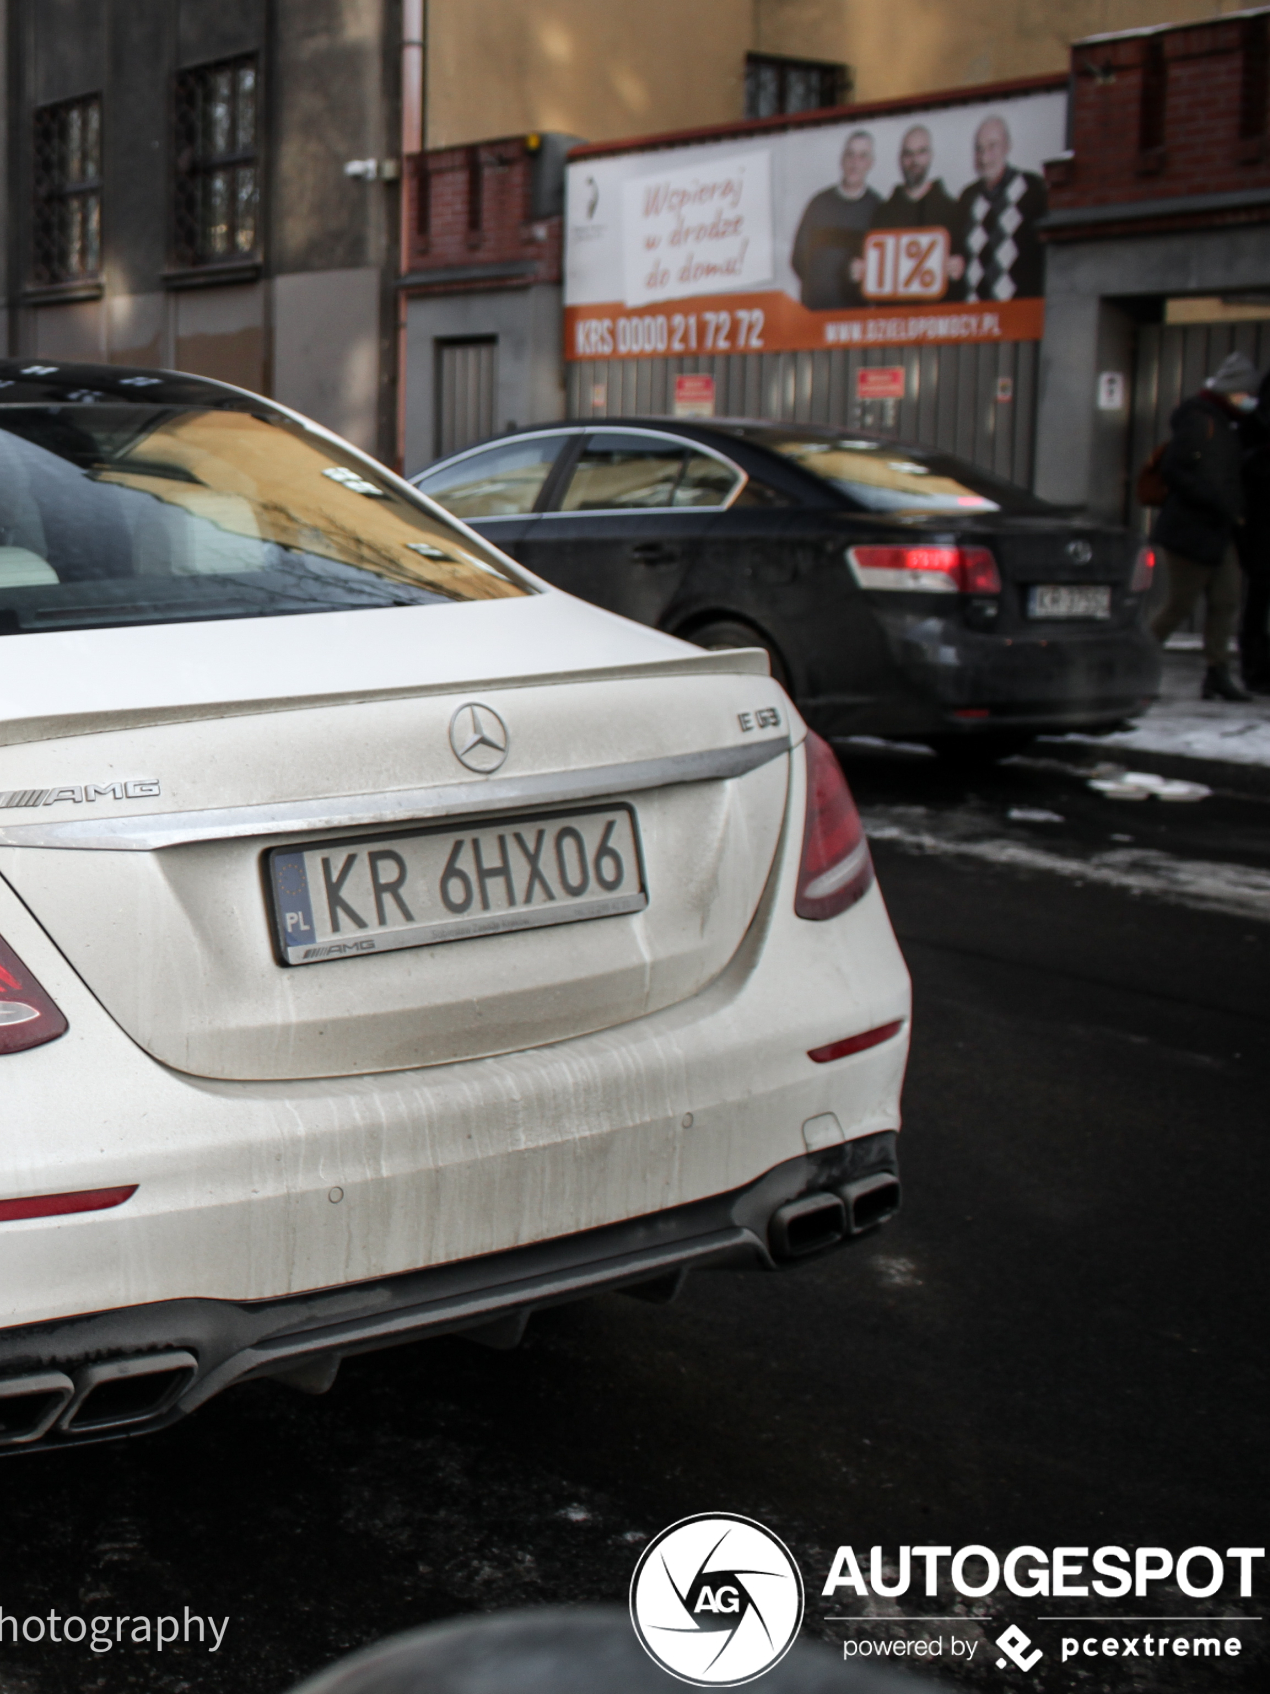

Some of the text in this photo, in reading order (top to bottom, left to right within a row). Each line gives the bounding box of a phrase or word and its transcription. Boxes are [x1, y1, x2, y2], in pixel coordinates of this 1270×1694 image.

[669, 207, 744, 246] drodze
[645, 258, 670, 289] do
[872, 240, 937, 288] 1%
[576, 308, 765, 355] KRS 0000 21 72 72
[737, 712, 754, 732] E
[43, 779, 161, 806] AMG
[321, 819, 626, 935] KR 6HX06
[286, 911, 310, 932] PL
[326, 940, 376, 955] AMG
